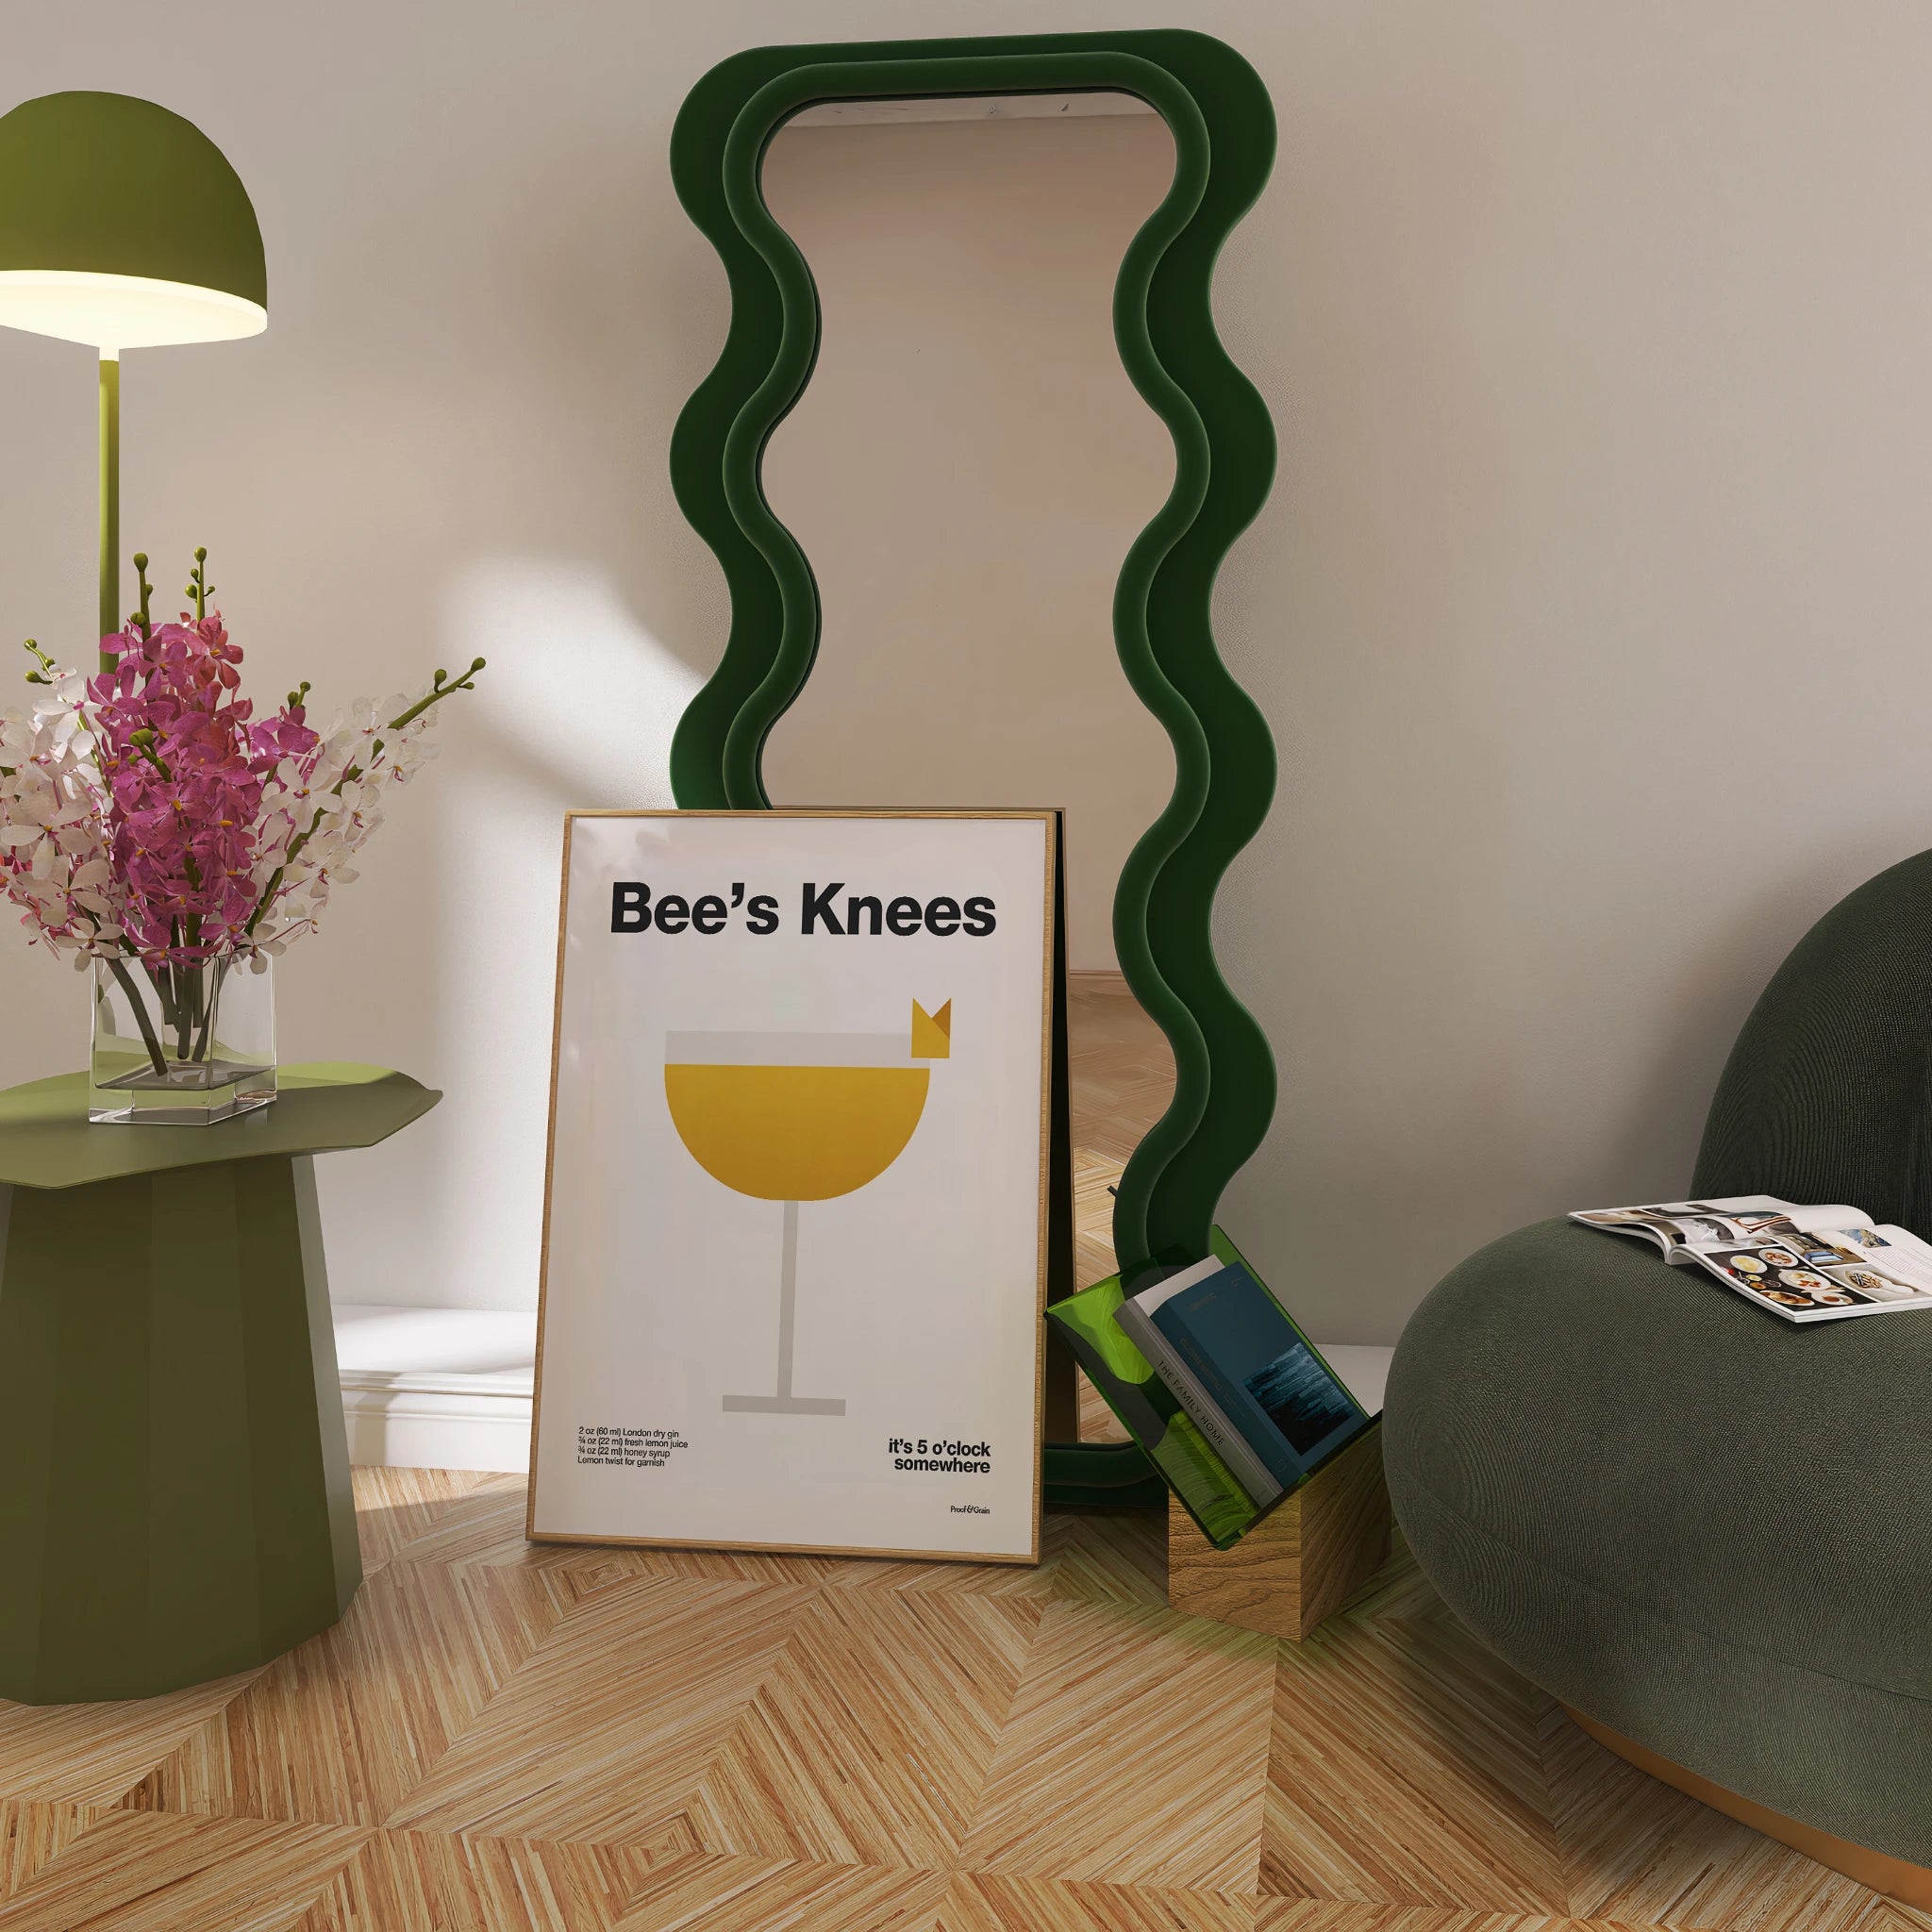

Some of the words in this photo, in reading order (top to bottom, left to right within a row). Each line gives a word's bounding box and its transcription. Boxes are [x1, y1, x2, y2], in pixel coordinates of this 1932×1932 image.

[611, 881, 779, 935] Bee’s
[801, 882, 996, 937] Knees
[1158, 1359, 1174, 1382] THE
[1173, 1379, 1202, 1414] FAMILY
[1200, 1412, 1225, 1446] HOME
[578, 1426, 584, 1435] 2
[596, 1427, 608, 1436] (60
[609, 1427, 622, 1437] ml)
[623, 1428, 651, 1437] London
[654, 1429, 665, 1439] dry
[668, 1429, 679, 1440] gin
[598, 1438, 610, 1446] (22
[611, 1438, 623, 1447] ml)
[625, 1439, 643, 1447] fresh
[645, 1440, 669, 1448] lemon
[670, 1440, 689, 1449] juice
[889, 1438, 913, 1454] it’s
[917, 1440, 928, 1455] 5
[932, 1441, 991, 1457] o’clock
[597, 1447, 609, 1456] (22
[610, 1447, 623, 1457] ml)
[624, 1448, 647, 1457] honey
[649, 1450, 671, 1458] syrup
[577, 1456, 604, 1464] Lemon
[605, 1457, 624, 1465] twist
[625, 1457, 635, 1466] for
[637, 1457, 665, 1467] garnish
[894, 1457, 991, 1474] somewhere
